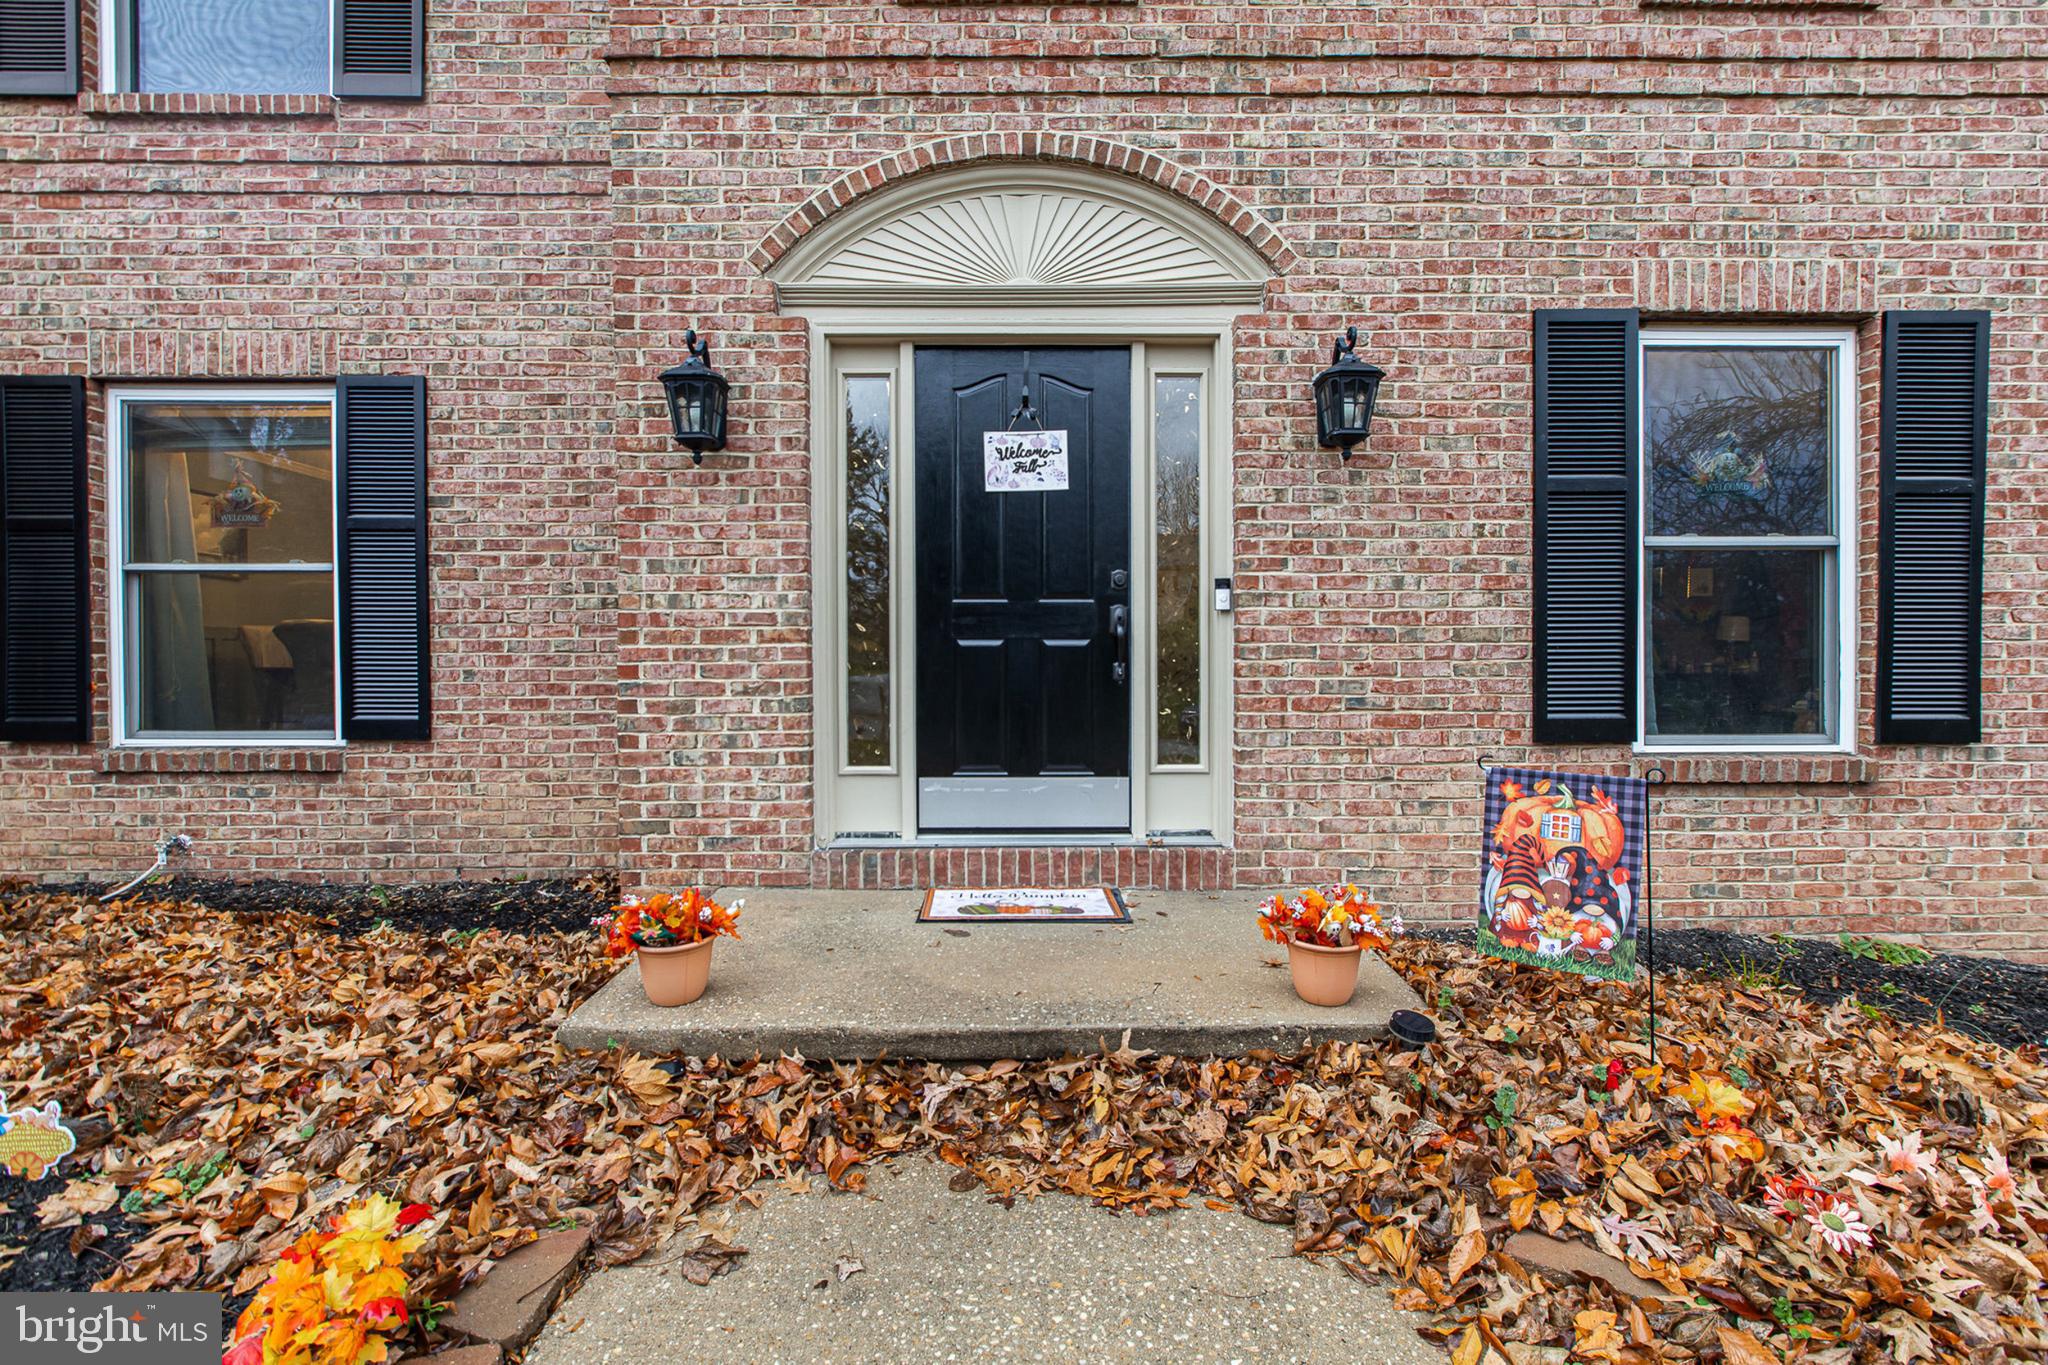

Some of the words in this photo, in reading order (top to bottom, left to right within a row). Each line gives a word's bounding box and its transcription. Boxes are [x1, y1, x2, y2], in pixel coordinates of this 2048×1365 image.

[995, 442, 1062, 461] Welcome
[1012, 458, 1047, 474] Fall
[1705, 482, 1749, 491] WELCOME
[221, 514, 260, 524] WELCOME
[1008, 891, 1087, 900] Pumpkin
